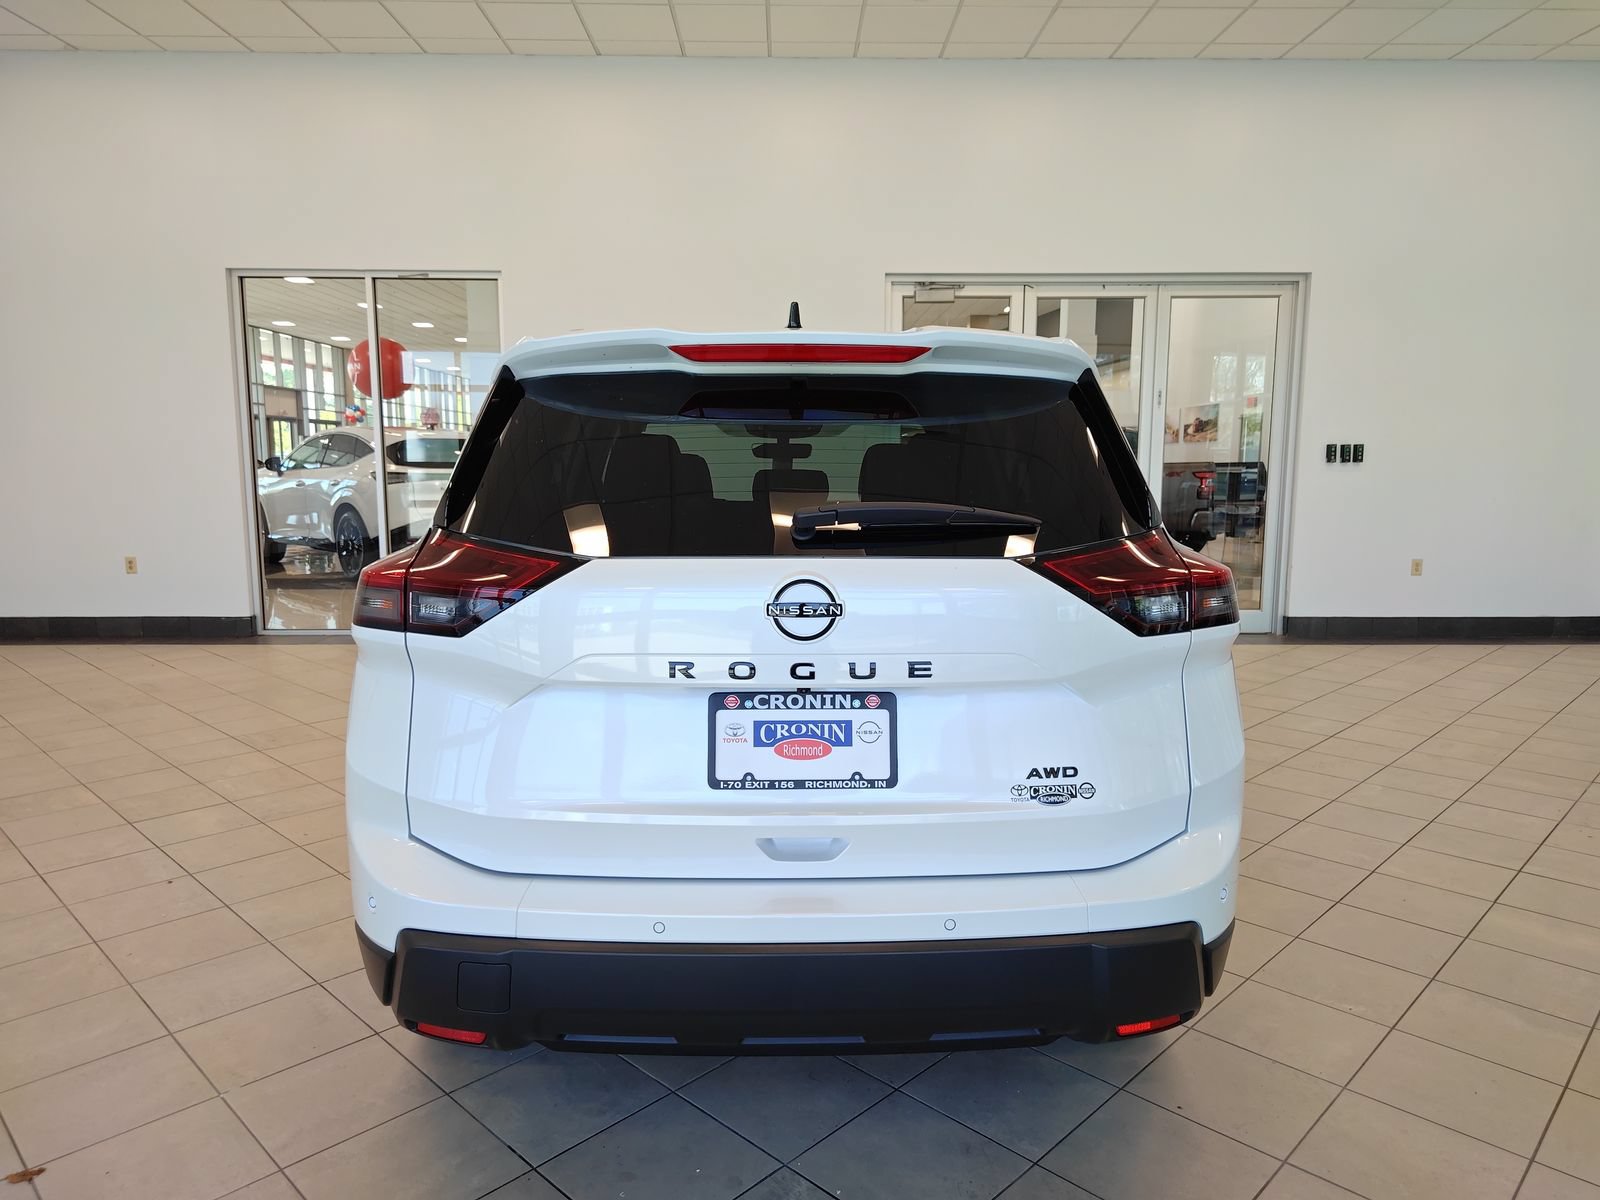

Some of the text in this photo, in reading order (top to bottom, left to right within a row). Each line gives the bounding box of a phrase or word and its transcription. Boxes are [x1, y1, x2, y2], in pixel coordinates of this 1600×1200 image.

[768, 605, 842, 616] NISSAN
[668, 661, 933, 680] ROGUE
[753, 694, 851, 709] CRONIN
[760, 723, 846, 744] CRONIN
[783, 744, 823, 757] Richmond
[1026, 766, 1078, 779] AWD
[720, 781, 742, 789] I-70
[745, 781, 770, 789] EXIT
[774, 781, 795, 789] 156
[874, 780, 887, 788] IN
[1030, 785, 1076, 797] CRONIN
